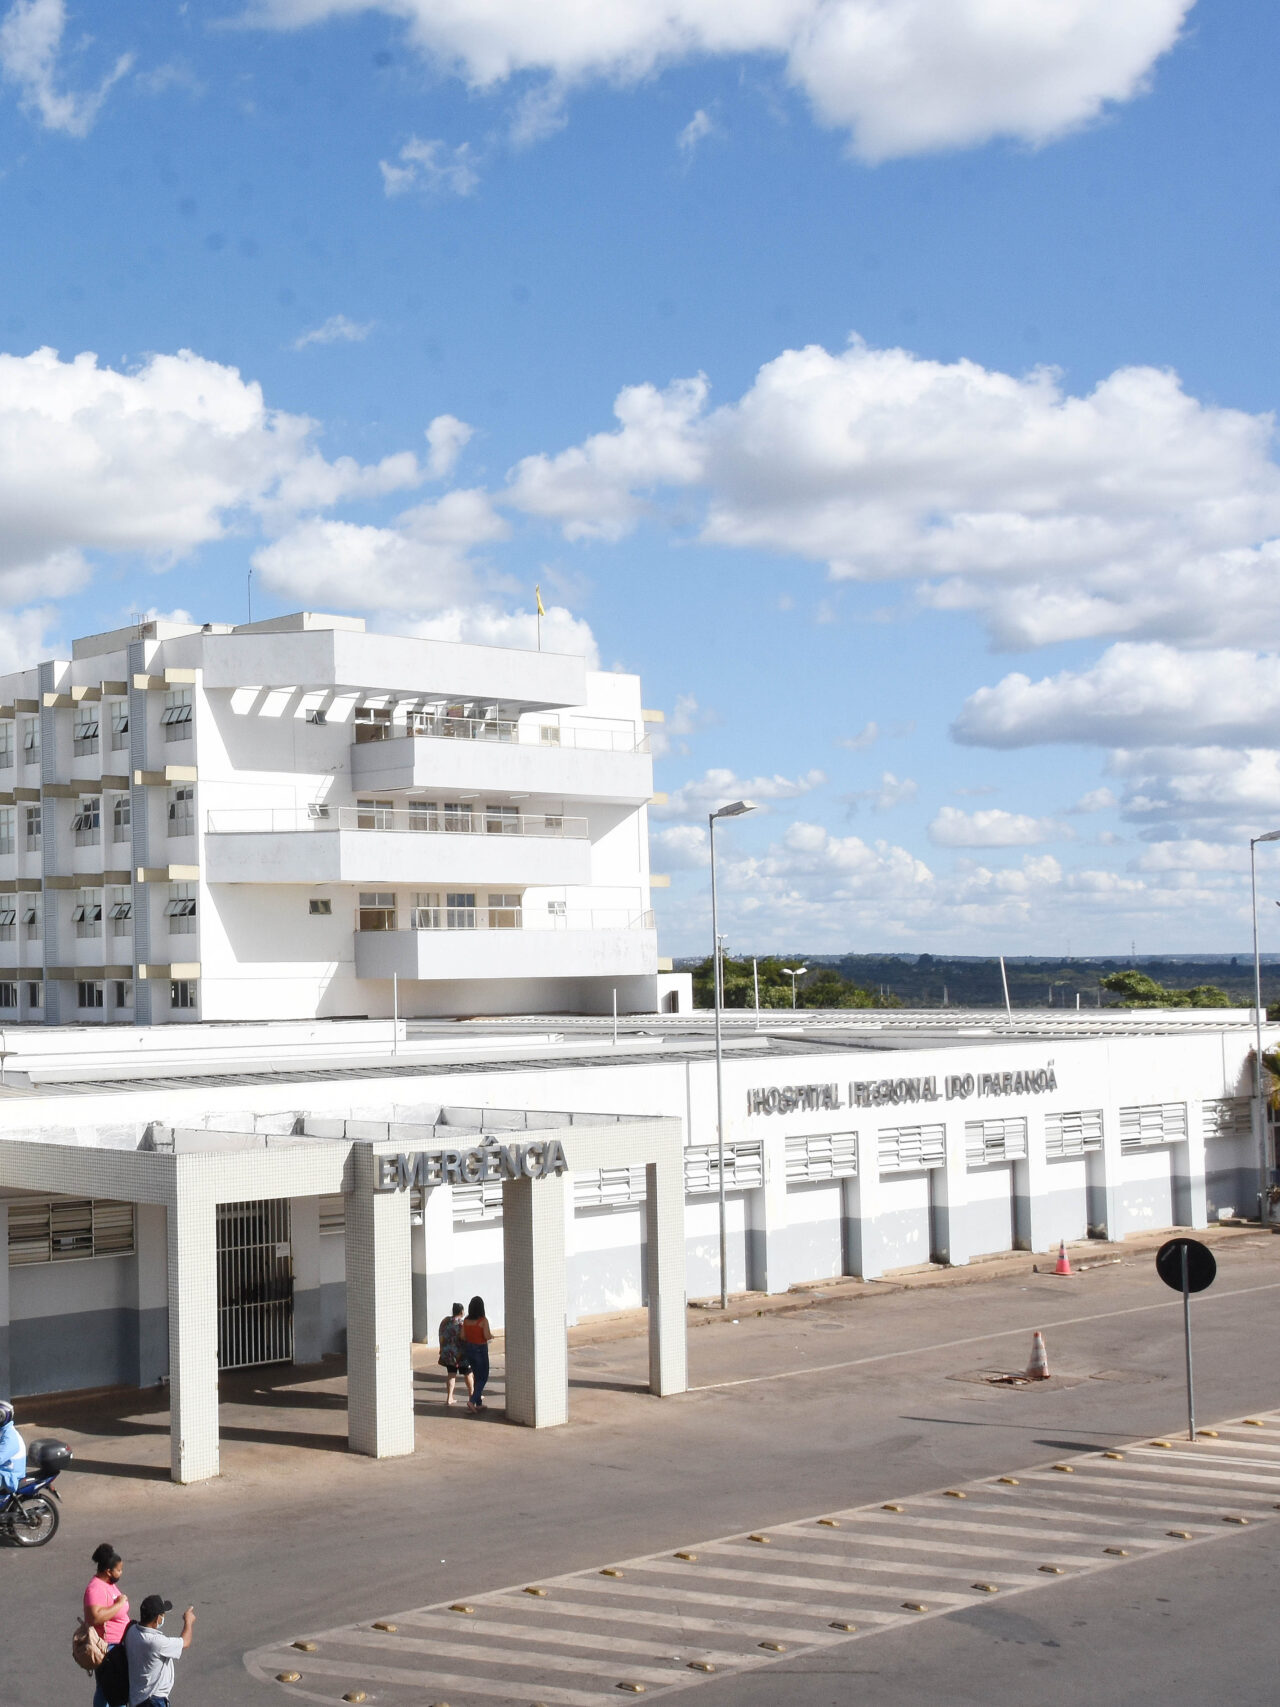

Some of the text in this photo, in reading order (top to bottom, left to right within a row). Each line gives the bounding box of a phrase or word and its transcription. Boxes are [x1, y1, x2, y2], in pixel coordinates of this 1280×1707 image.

[748, 1058, 1058, 1116] HOSPITAL REGIONAL DO PARANOÁ
[374, 1135, 568, 1192] EMERGÊNCIA
